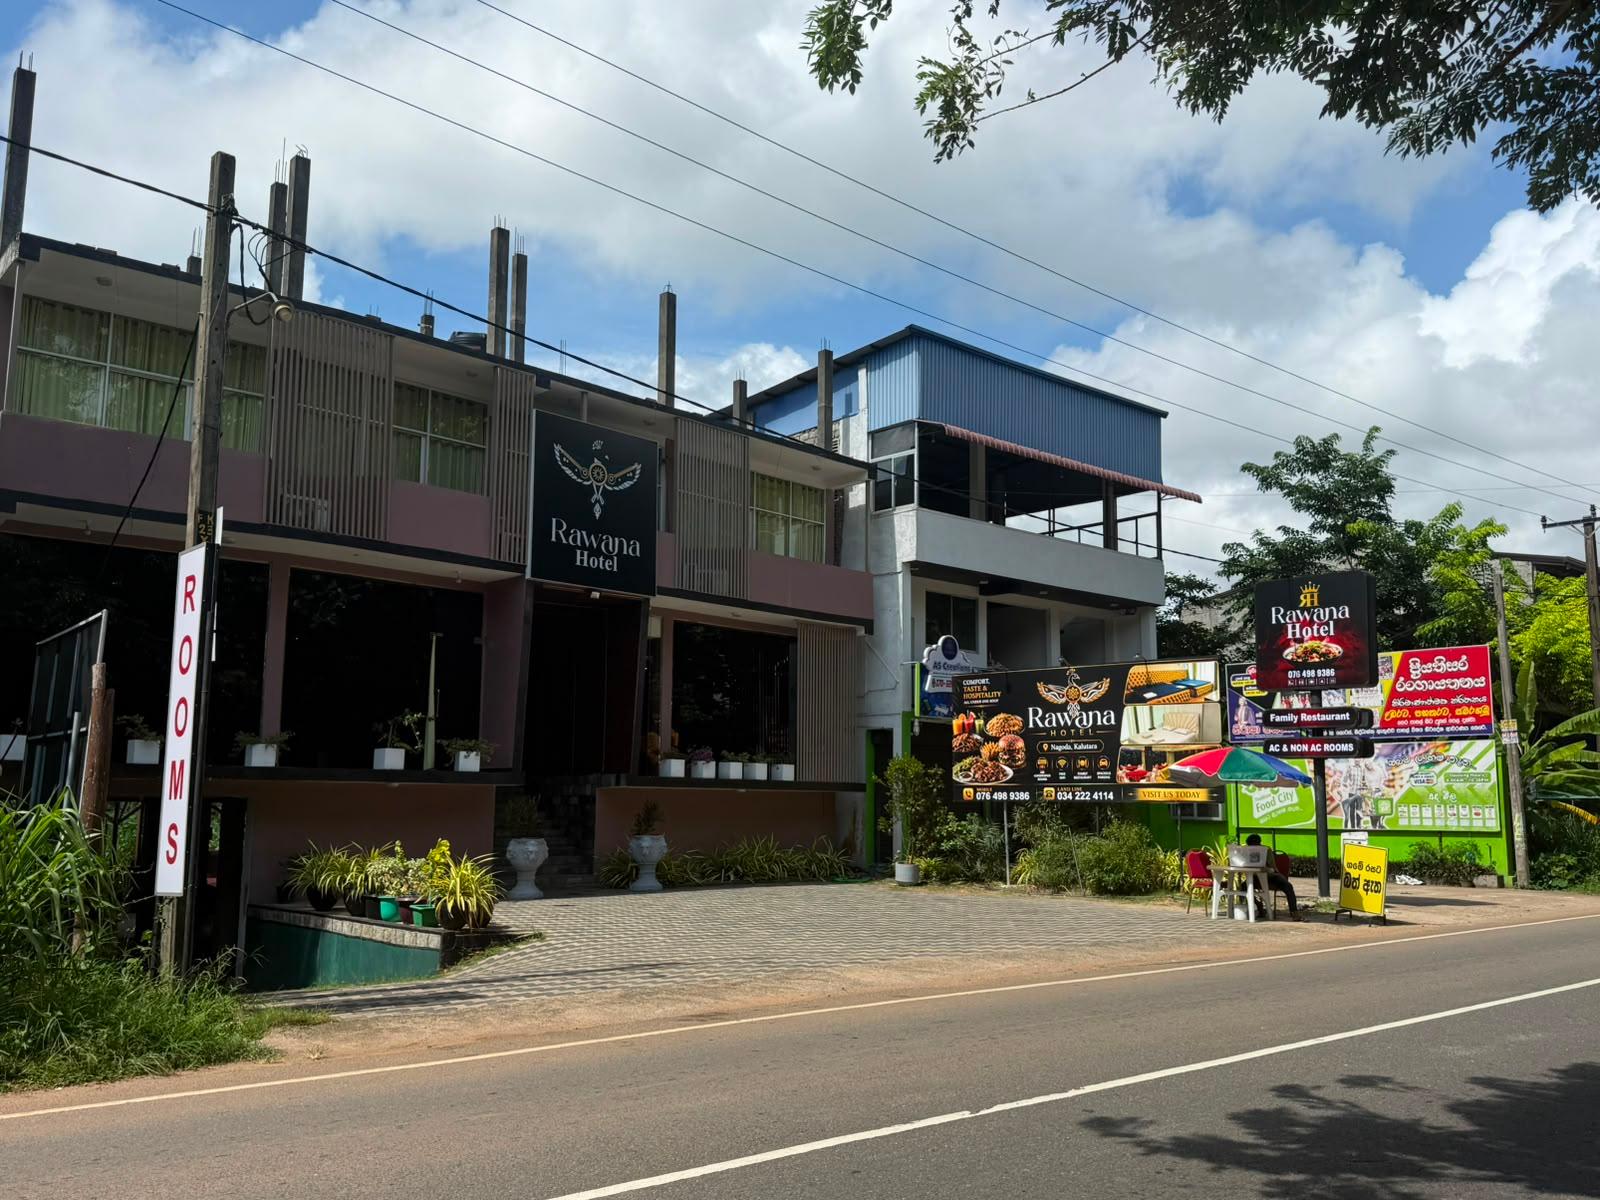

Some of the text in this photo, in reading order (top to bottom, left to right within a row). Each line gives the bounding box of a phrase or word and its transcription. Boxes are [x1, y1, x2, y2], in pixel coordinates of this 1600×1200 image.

[551, 518, 641, 557] Rawana
[576, 550, 618, 572] Hotel
[1271, 605, 1350, 624] Rawana
[1287, 620, 1335, 639] Hotel
[1287, 668, 1335, 679] 076 498 9386
[963, 691, 1001, 699] HOSPITALITY
[165, 574, 197, 865] ROOMS
[1028, 706, 1116, 729] Rawana
[1270, 713, 1298, 723] Family
[1300, 712, 1350, 722] Restaurant
[1050, 728, 1094, 737] HOTEL
[1051, 744, 1072, 752] Nagoda,
[1269, 744, 1280, 752] AC
[1282, 744, 1288, 752] &
[1290, 744, 1308, 752] NON
[1323, 743, 1354, 752] ROOMS
[976, 792, 1030, 800] 076 498 9386
[1057, 792, 1114, 800] 034 222 4114
[1256, 796, 1276, 813] Food
[1278, 790, 1294, 803] City
